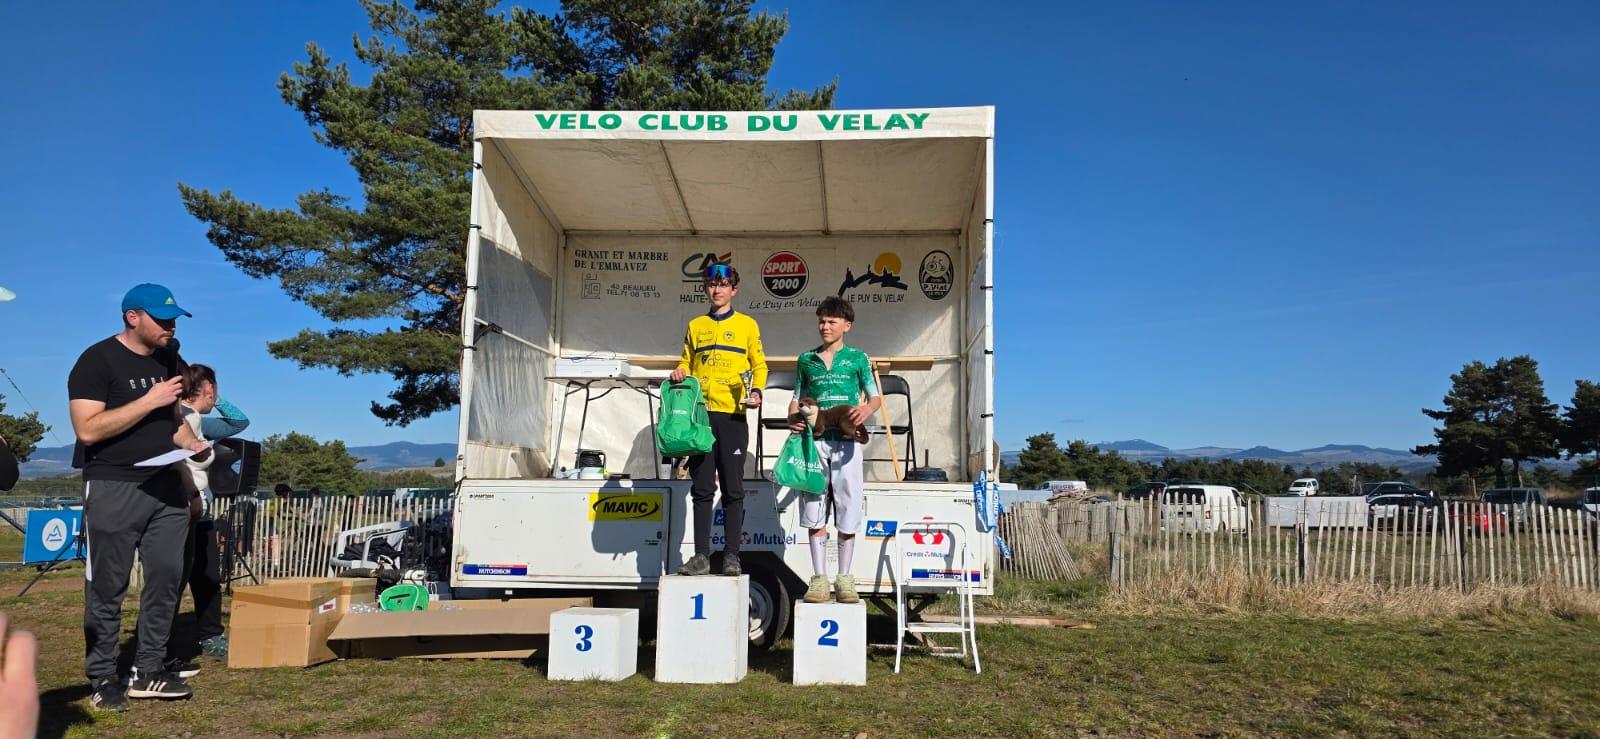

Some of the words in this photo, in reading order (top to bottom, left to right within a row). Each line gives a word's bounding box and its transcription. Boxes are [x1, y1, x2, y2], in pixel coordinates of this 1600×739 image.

[535, 114, 622, 129] VELO
[638, 114, 729, 131] CLUB
[747, 115, 798, 132] DU
[817, 113, 931, 131] VELAY
[574, 249, 609, 259] GRANIT
[613, 250, 625, 259] ET
[628, 251, 669, 261] MARBRE
[574, 260, 587, 269] DE
[590, 261, 648, 272] L'EMBLAVEZ
[765, 262, 802, 274] SPORT
[771, 279, 800, 290] 2000
[847, 294, 856, 303] LE
[858, 294, 870, 303] PUY
[873, 294, 882, 302] EN
[885, 293, 905, 302] VELAY
[749, 300, 761, 309] Le
[763, 300, 782, 311] Puy
[602, 502, 649, 513] MAVIC
[753, 533, 797, 545] Mutuel
[689, 593, 708, 620] 1
[574, 624, 594, 651] 3
[817, 619, 839, 647] 2
